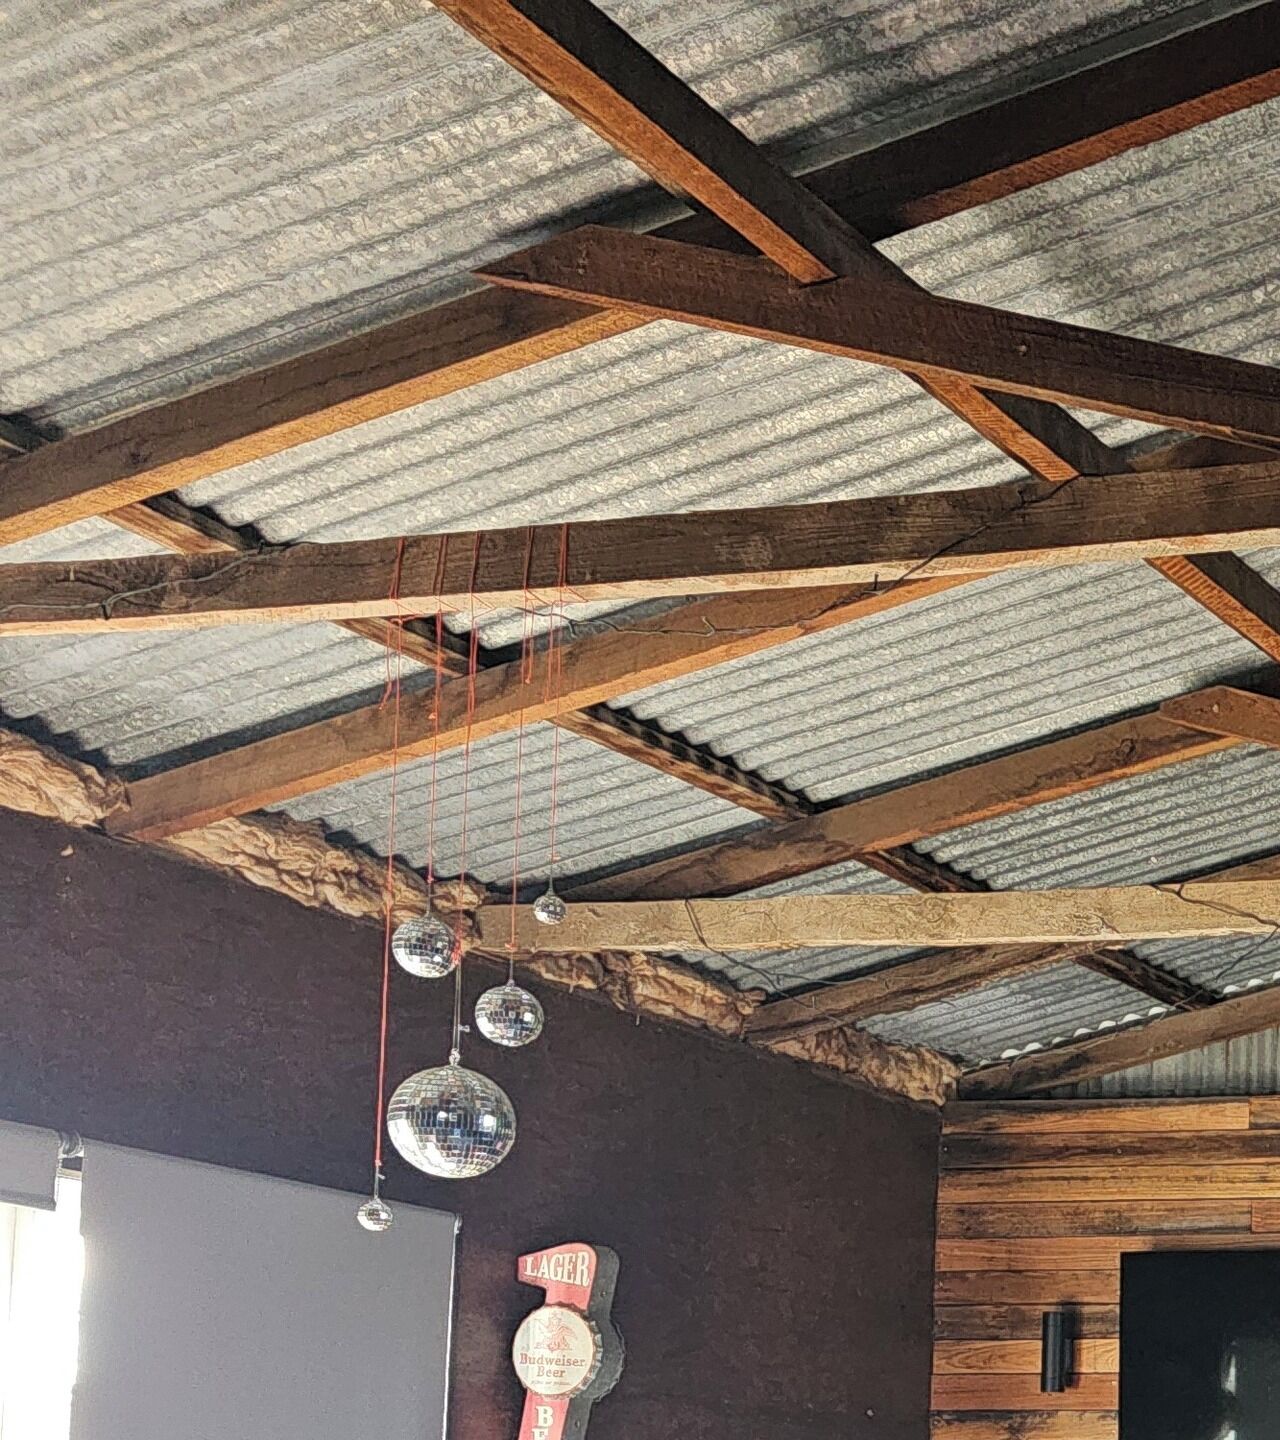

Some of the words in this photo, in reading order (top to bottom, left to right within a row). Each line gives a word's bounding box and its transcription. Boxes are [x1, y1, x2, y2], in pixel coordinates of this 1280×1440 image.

[524, 1251, 590, 1287] LAGER
[519, 1353, 586, 1367] Budweiser
[536, 1366, 566, 1377] Beer
